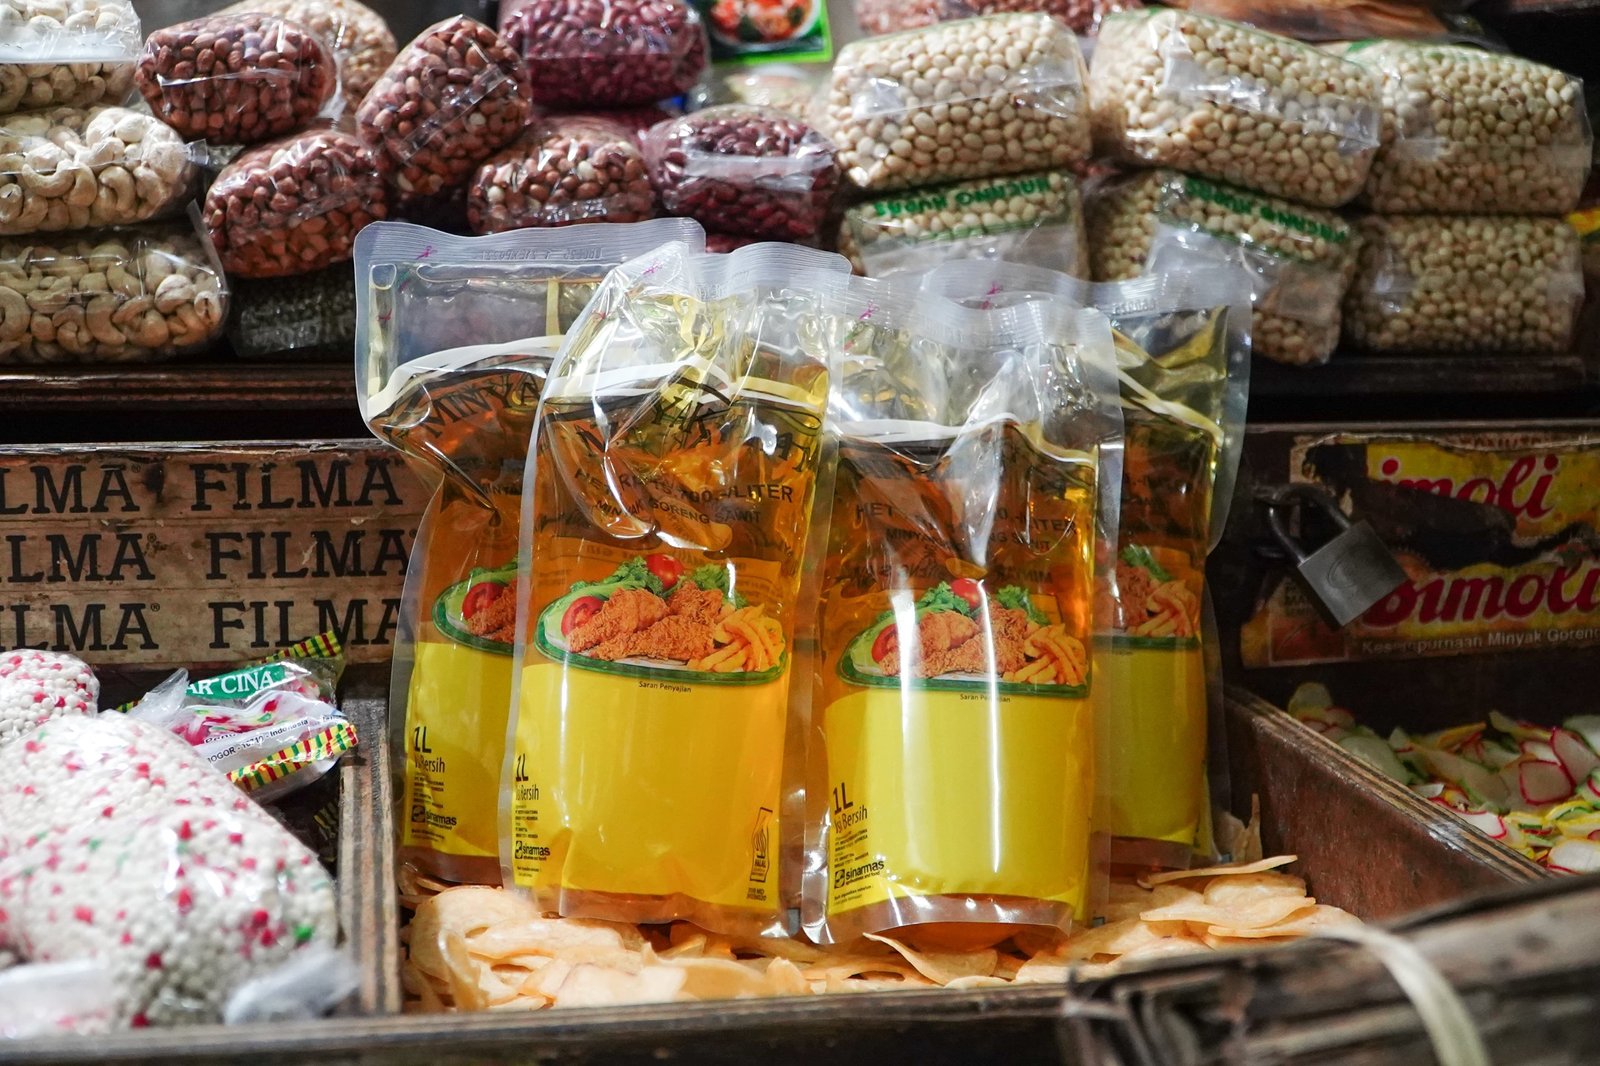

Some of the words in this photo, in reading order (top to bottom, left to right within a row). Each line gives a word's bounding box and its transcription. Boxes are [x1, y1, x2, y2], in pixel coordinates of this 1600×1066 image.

[190, 458, 403, 511] FILMA
[595, 499, 642, 520] MINAK
[0, 603, 160, 651] LMA
[1488, 629, 1542, 648] Minyak
[220, 670, 275, 694] CINA
[639, 681, 658, 689] Saran
[659, 682, 692, 693] Penyajian
[960, 693, 979, 701] Saran
[414, 726, 432, 753] 1L
[516, 753, 529, 781] 1L
[833, 782, 854, 815] 1L
[842, 804, 868, 829] Bersih
[522, 845, 551, 856] sinarmas
[845, 860, 885, 880] sinarmas
